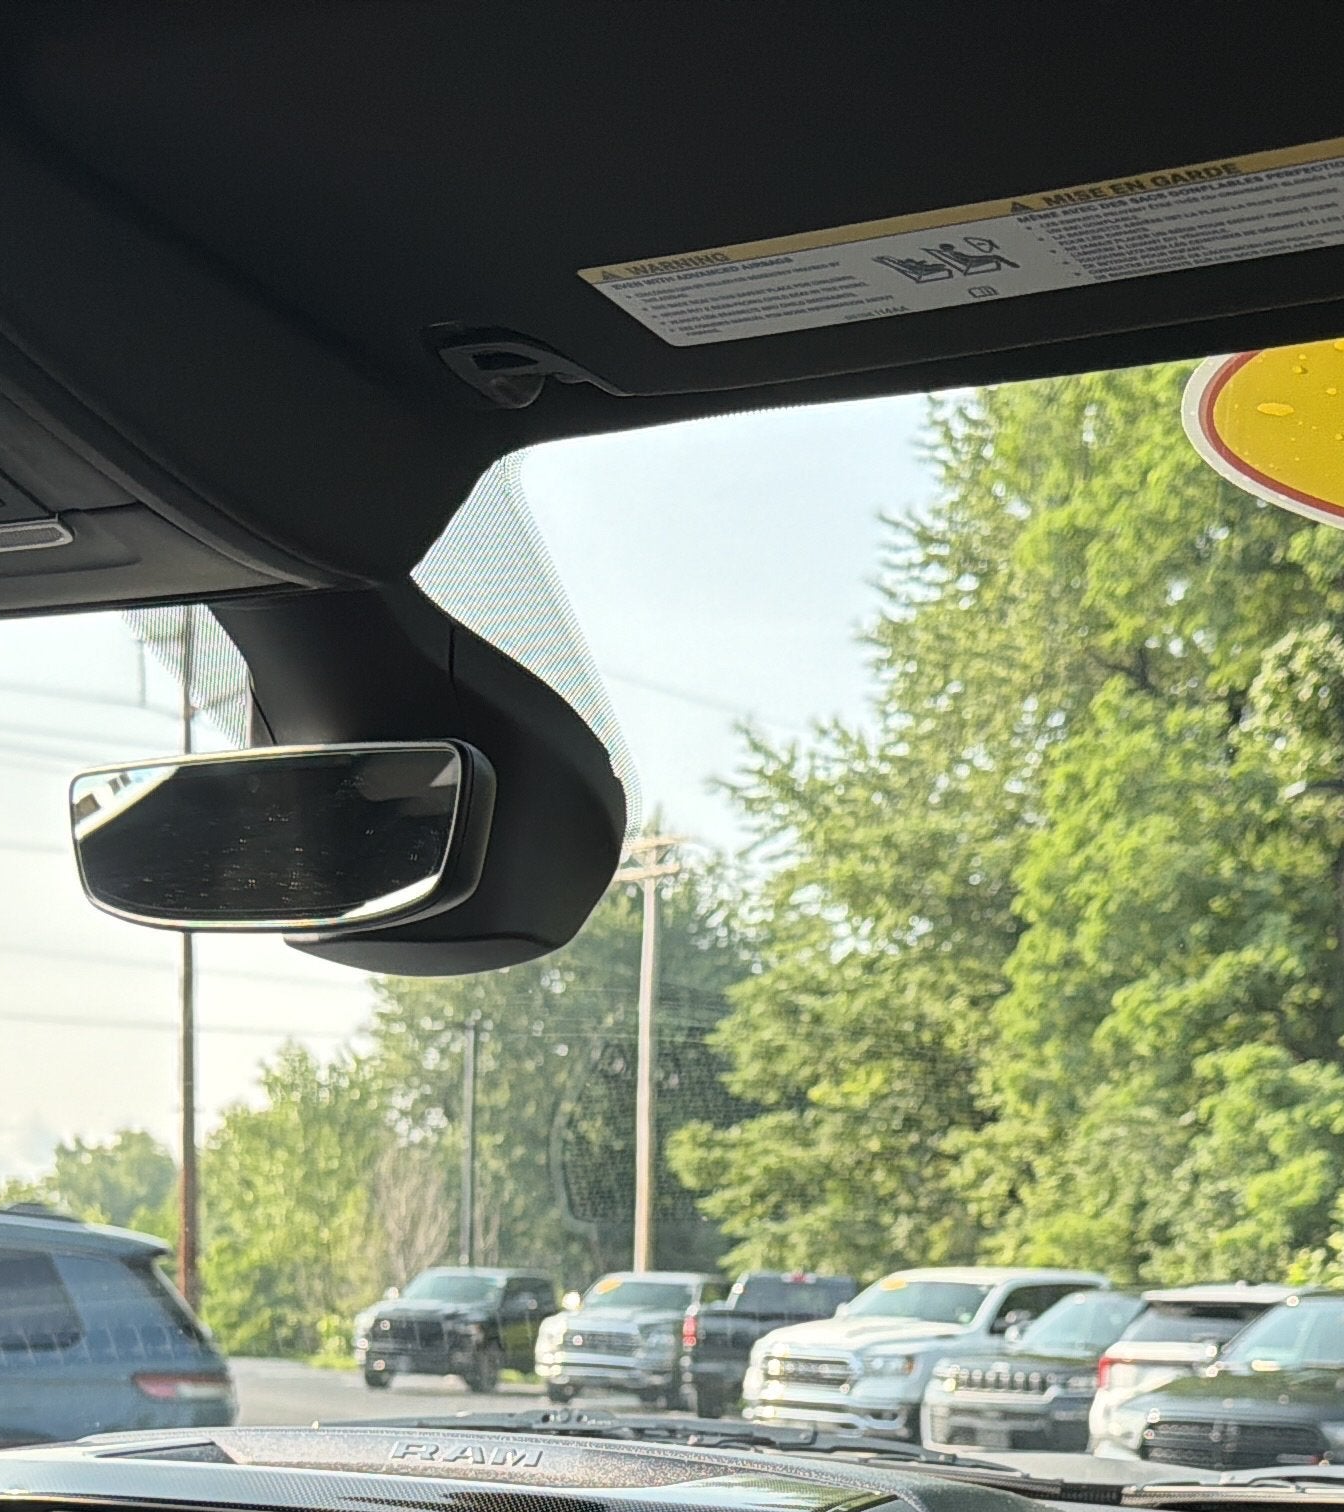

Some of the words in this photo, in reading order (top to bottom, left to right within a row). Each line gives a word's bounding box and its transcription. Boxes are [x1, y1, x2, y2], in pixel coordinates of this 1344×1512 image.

[1043, 182, 1109, 206] MISE
[1113, 177, 1147, 199] EN
[1155, 162, 1242, 188] GARDE
[626, 252, 731, 276] WARNING
[391, 1440, 544, 1467] RAM
